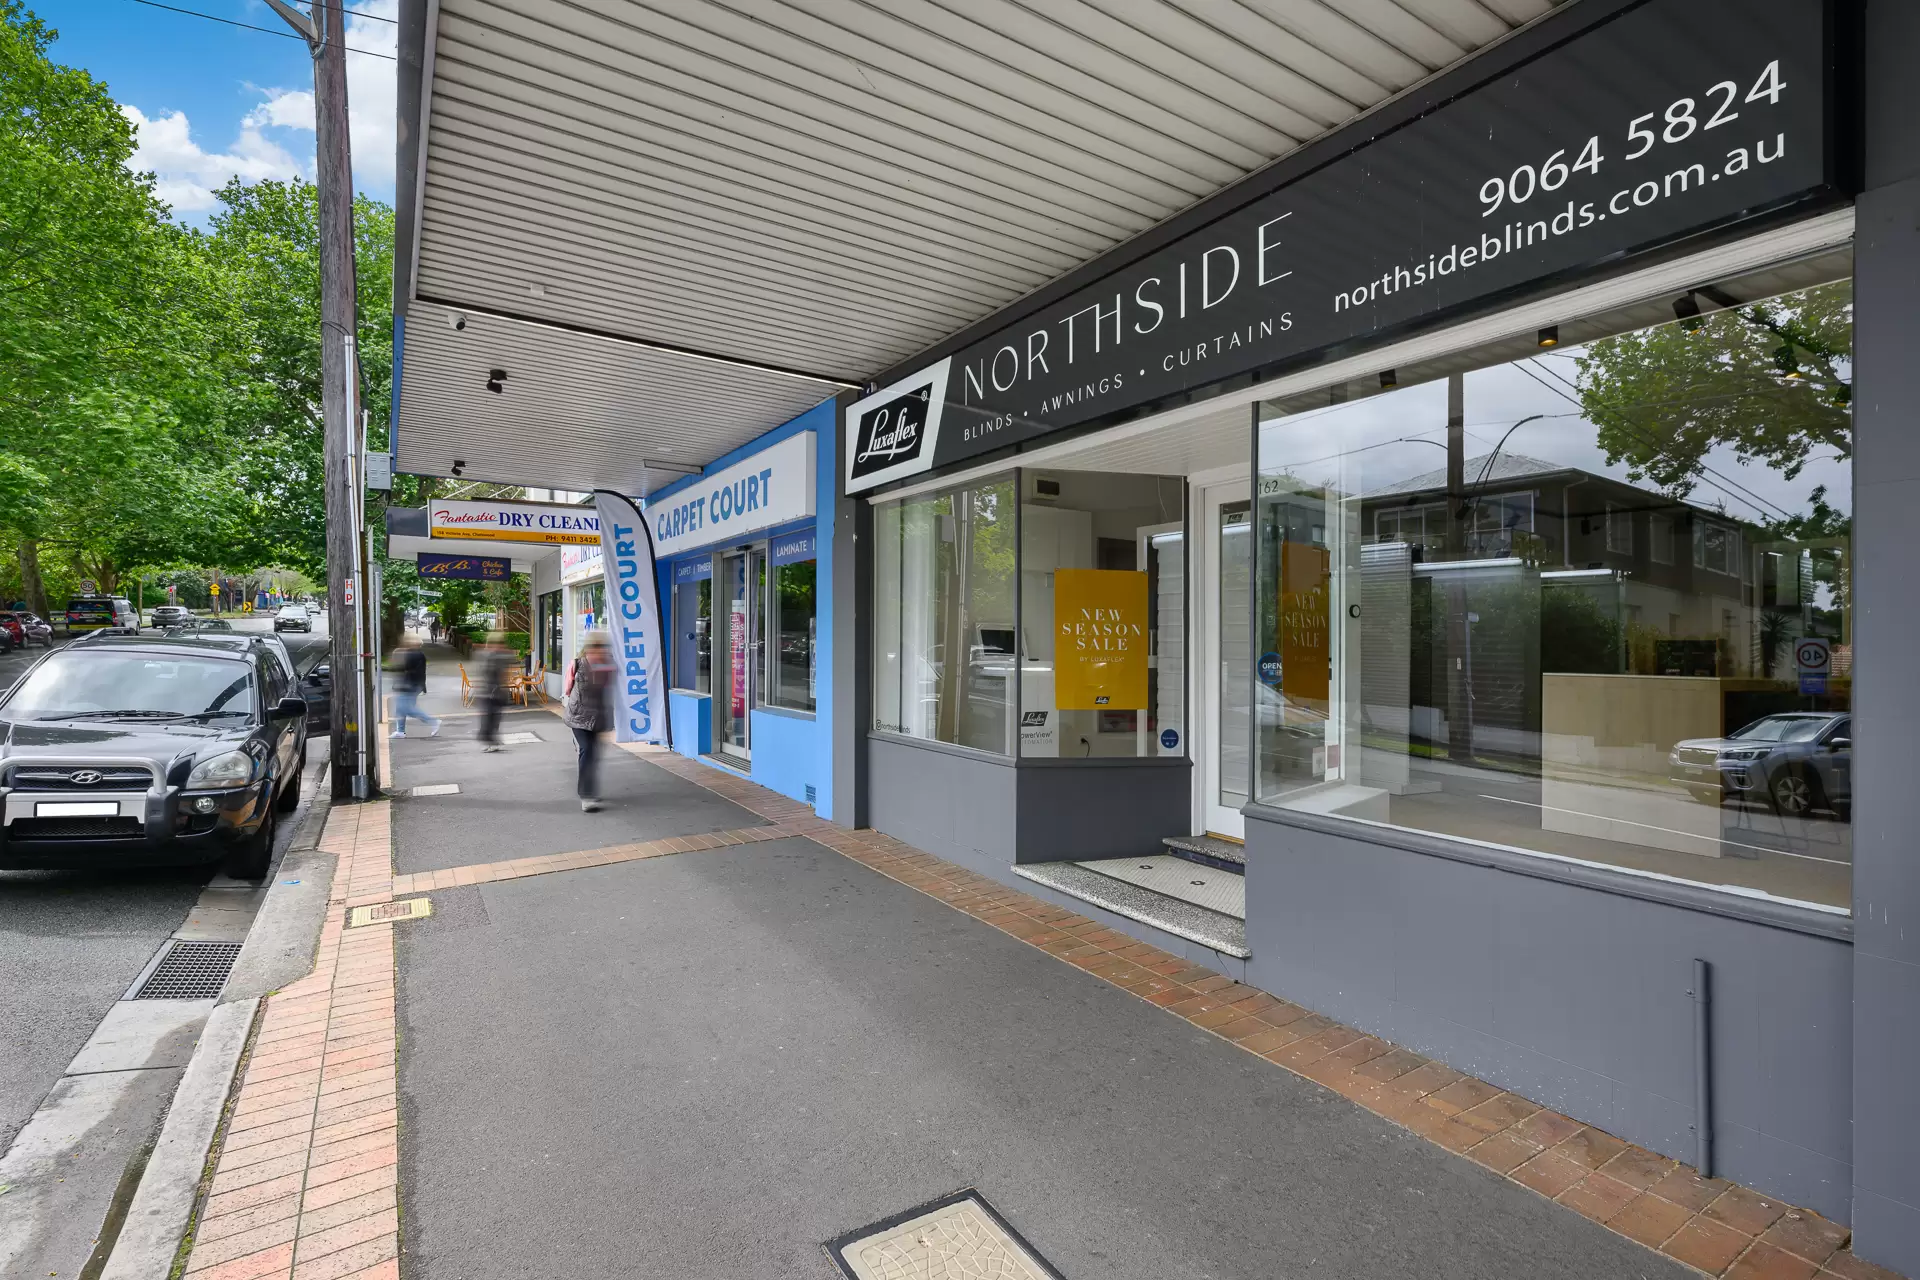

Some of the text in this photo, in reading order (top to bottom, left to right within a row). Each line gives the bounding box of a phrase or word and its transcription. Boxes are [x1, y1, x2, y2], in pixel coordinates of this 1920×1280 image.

[1479, 59, 1787, 217] 9064 5824
[1333, 132, 1786, 313] northsideblinds.com.au
[964, 211, 1293, 407] NORTHSIDE
[963, 311, 1293, 442] BLINDS AWNINGS CURTAINS
[1258, 479, 1279, 495] 162
[657, 467, 772, 541] CARPET COURT
[434, 510, 600, 531] Fantastic DRY CLEANI
[560, 535, 577, 543] 9411
[579, 536, 598, 544] 3425
[776, 540, 808, 557] LAMINATE
[1080, 608, 1124, 621] NEW
[614, 524, 650, 735] CARPET COURT
[1061, 623, 1141, 636] SEASON
[1076, 638, 1129, 651] SALE
